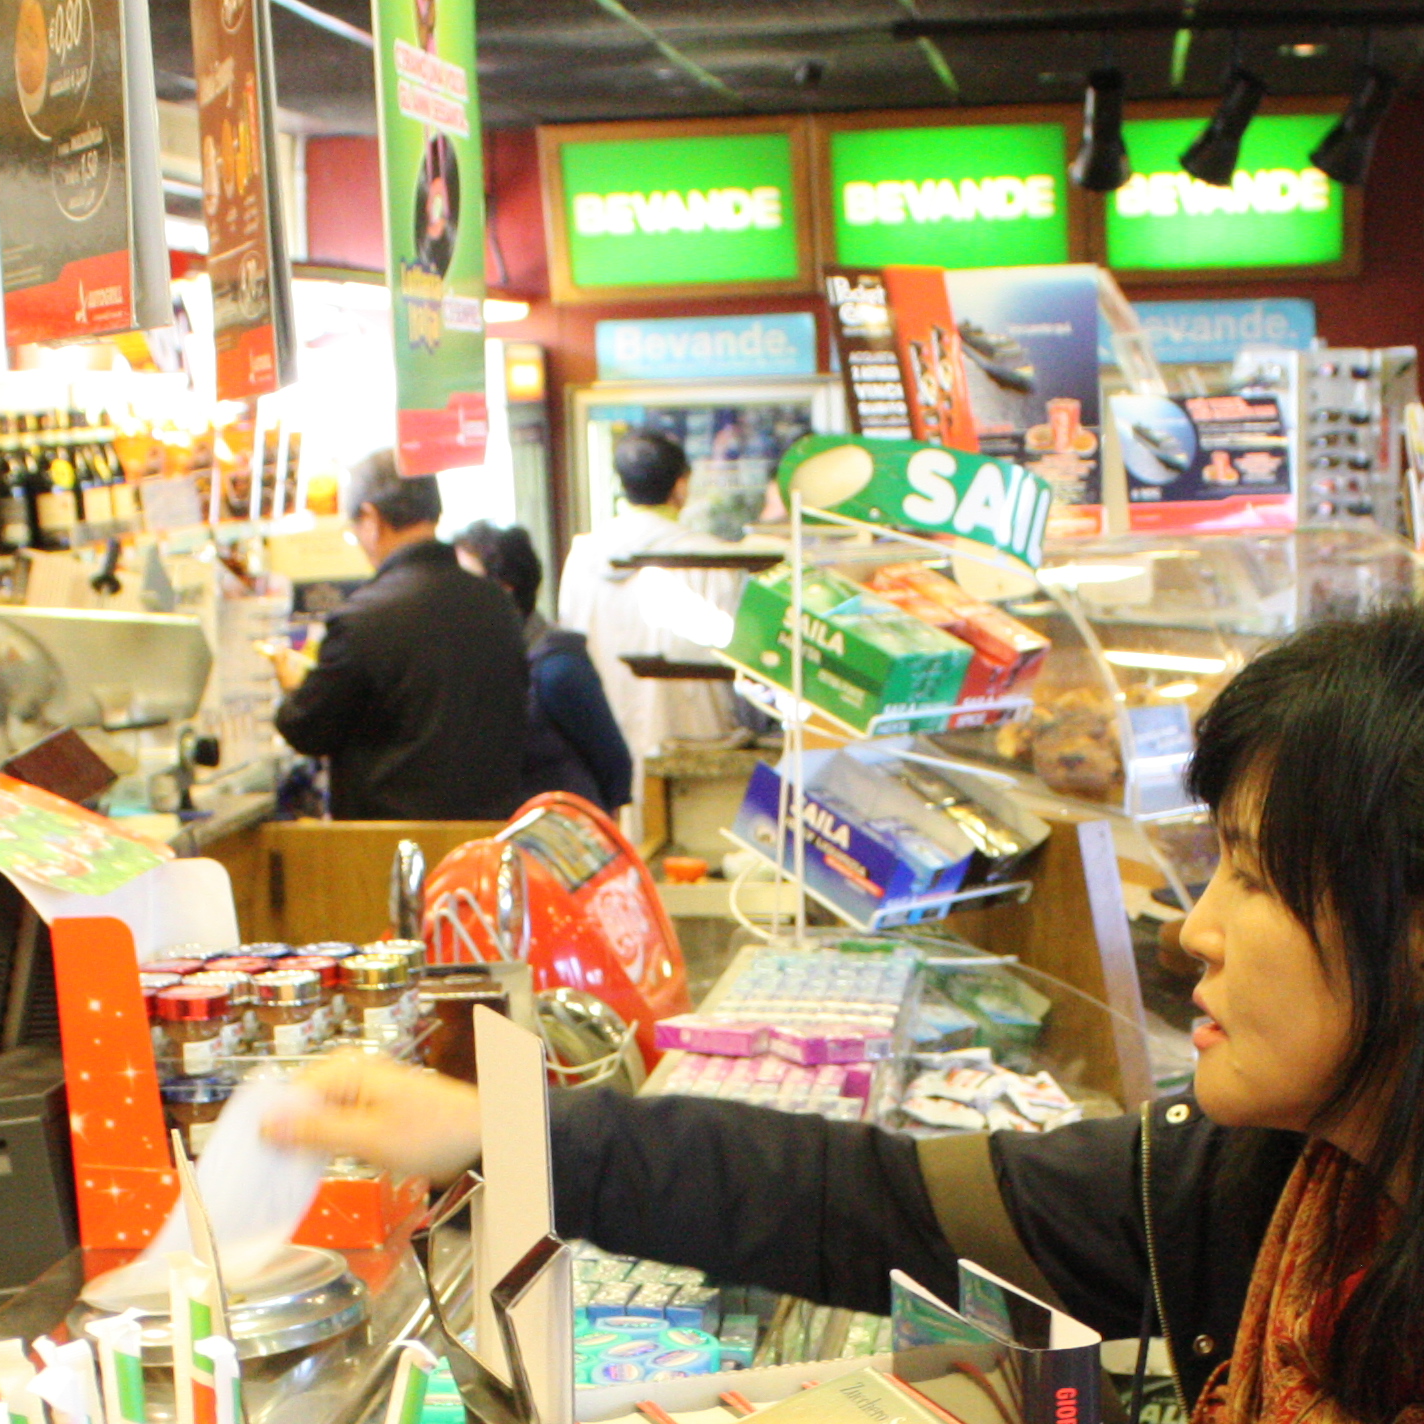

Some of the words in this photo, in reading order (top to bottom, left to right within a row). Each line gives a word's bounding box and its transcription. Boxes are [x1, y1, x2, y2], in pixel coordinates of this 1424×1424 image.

[573, 186, 782, 236] BEVANDE
[843, 176, 1056, 225] BEVANDE
[1115, 168, 1330, 217] BEVANDE
[1142, 303, 1299, 343] evande.
[901, 448, 1052, 567] SAIL
[839, 1381, 888, 1423] Zucchero
